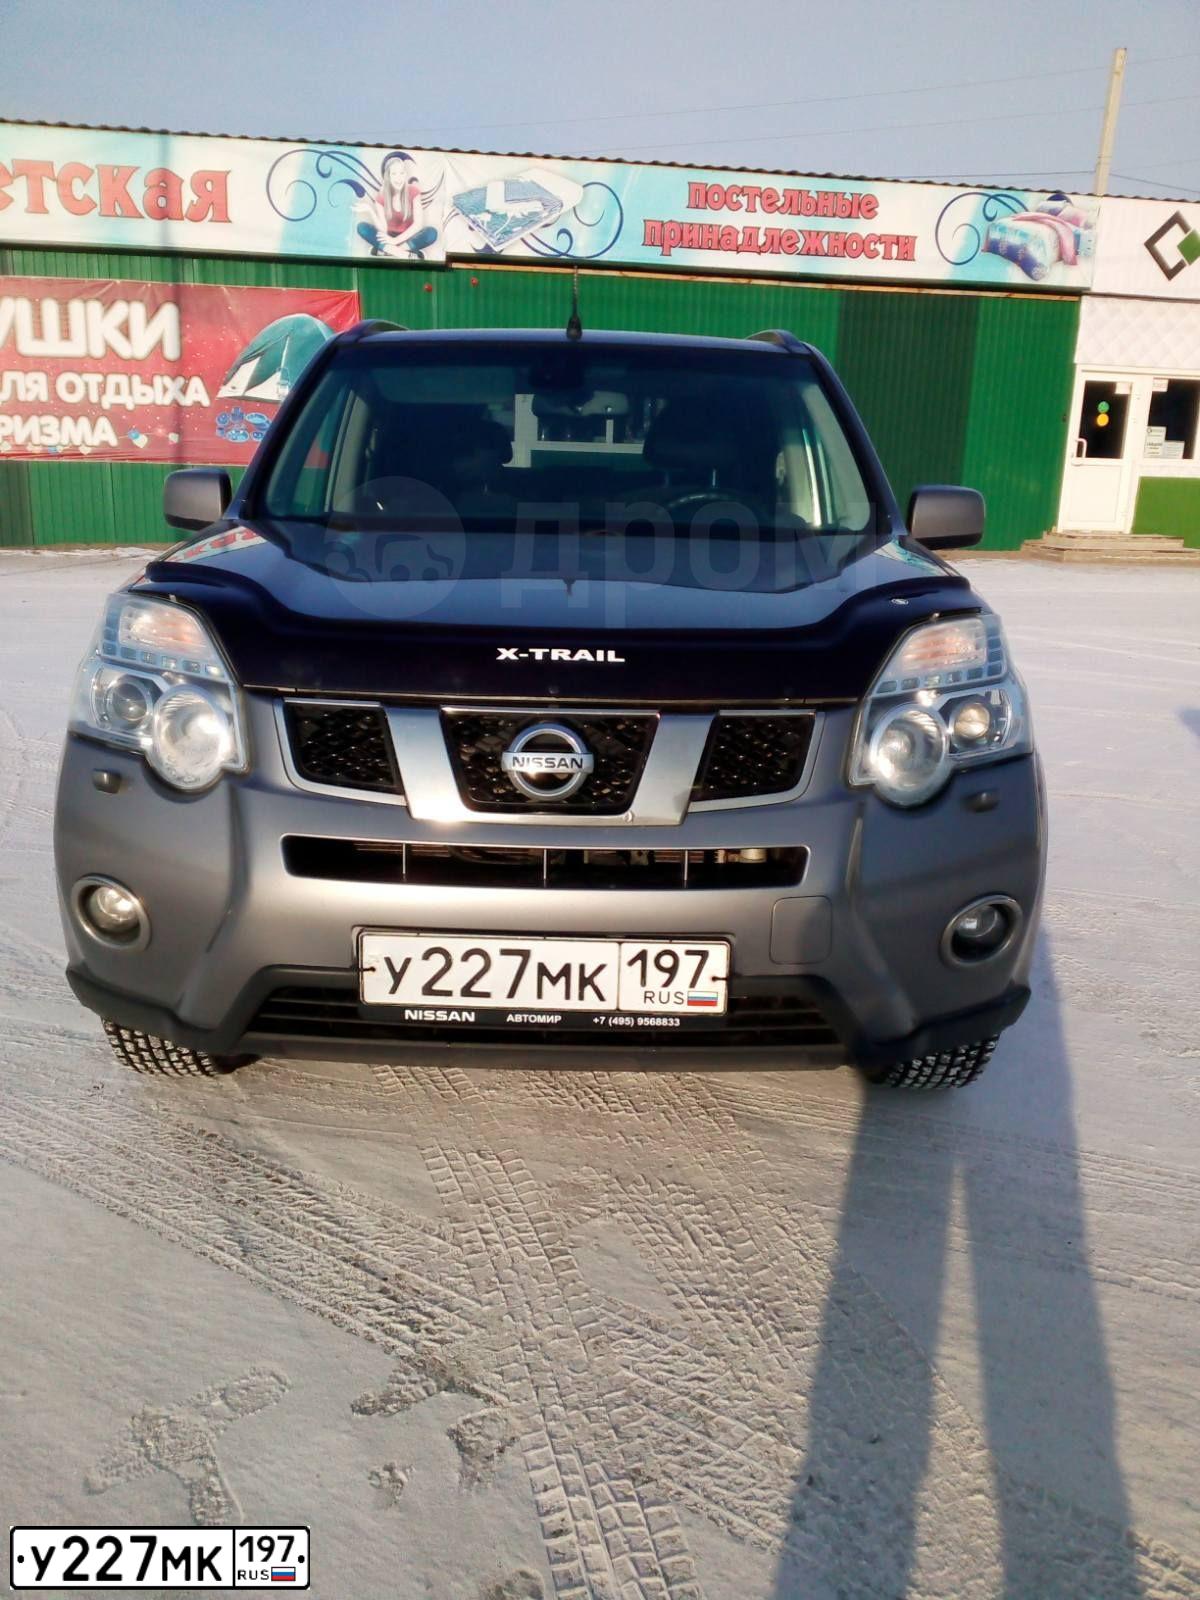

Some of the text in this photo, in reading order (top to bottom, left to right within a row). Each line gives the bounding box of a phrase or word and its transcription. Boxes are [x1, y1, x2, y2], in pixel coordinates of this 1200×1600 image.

[686, 181, 879, 220] постельные
[642, 219, 918, 261] принадлежности
[55, 372, 211, 411] ОТДЫХА
[496, 647, 626, 663] X-TRAIL
[512, 756, 584, 769] NISSAN
[627, 949, 710, 989] 197
[643, 991, 685, 1005] RUS
[404, 1009, 476, 1022] NISSAN
[506, 1013, 562, 1024] АВТОМИР
[592, 1016, 606, 1025] +7
[608, 1016, 635, 1027] (495)
